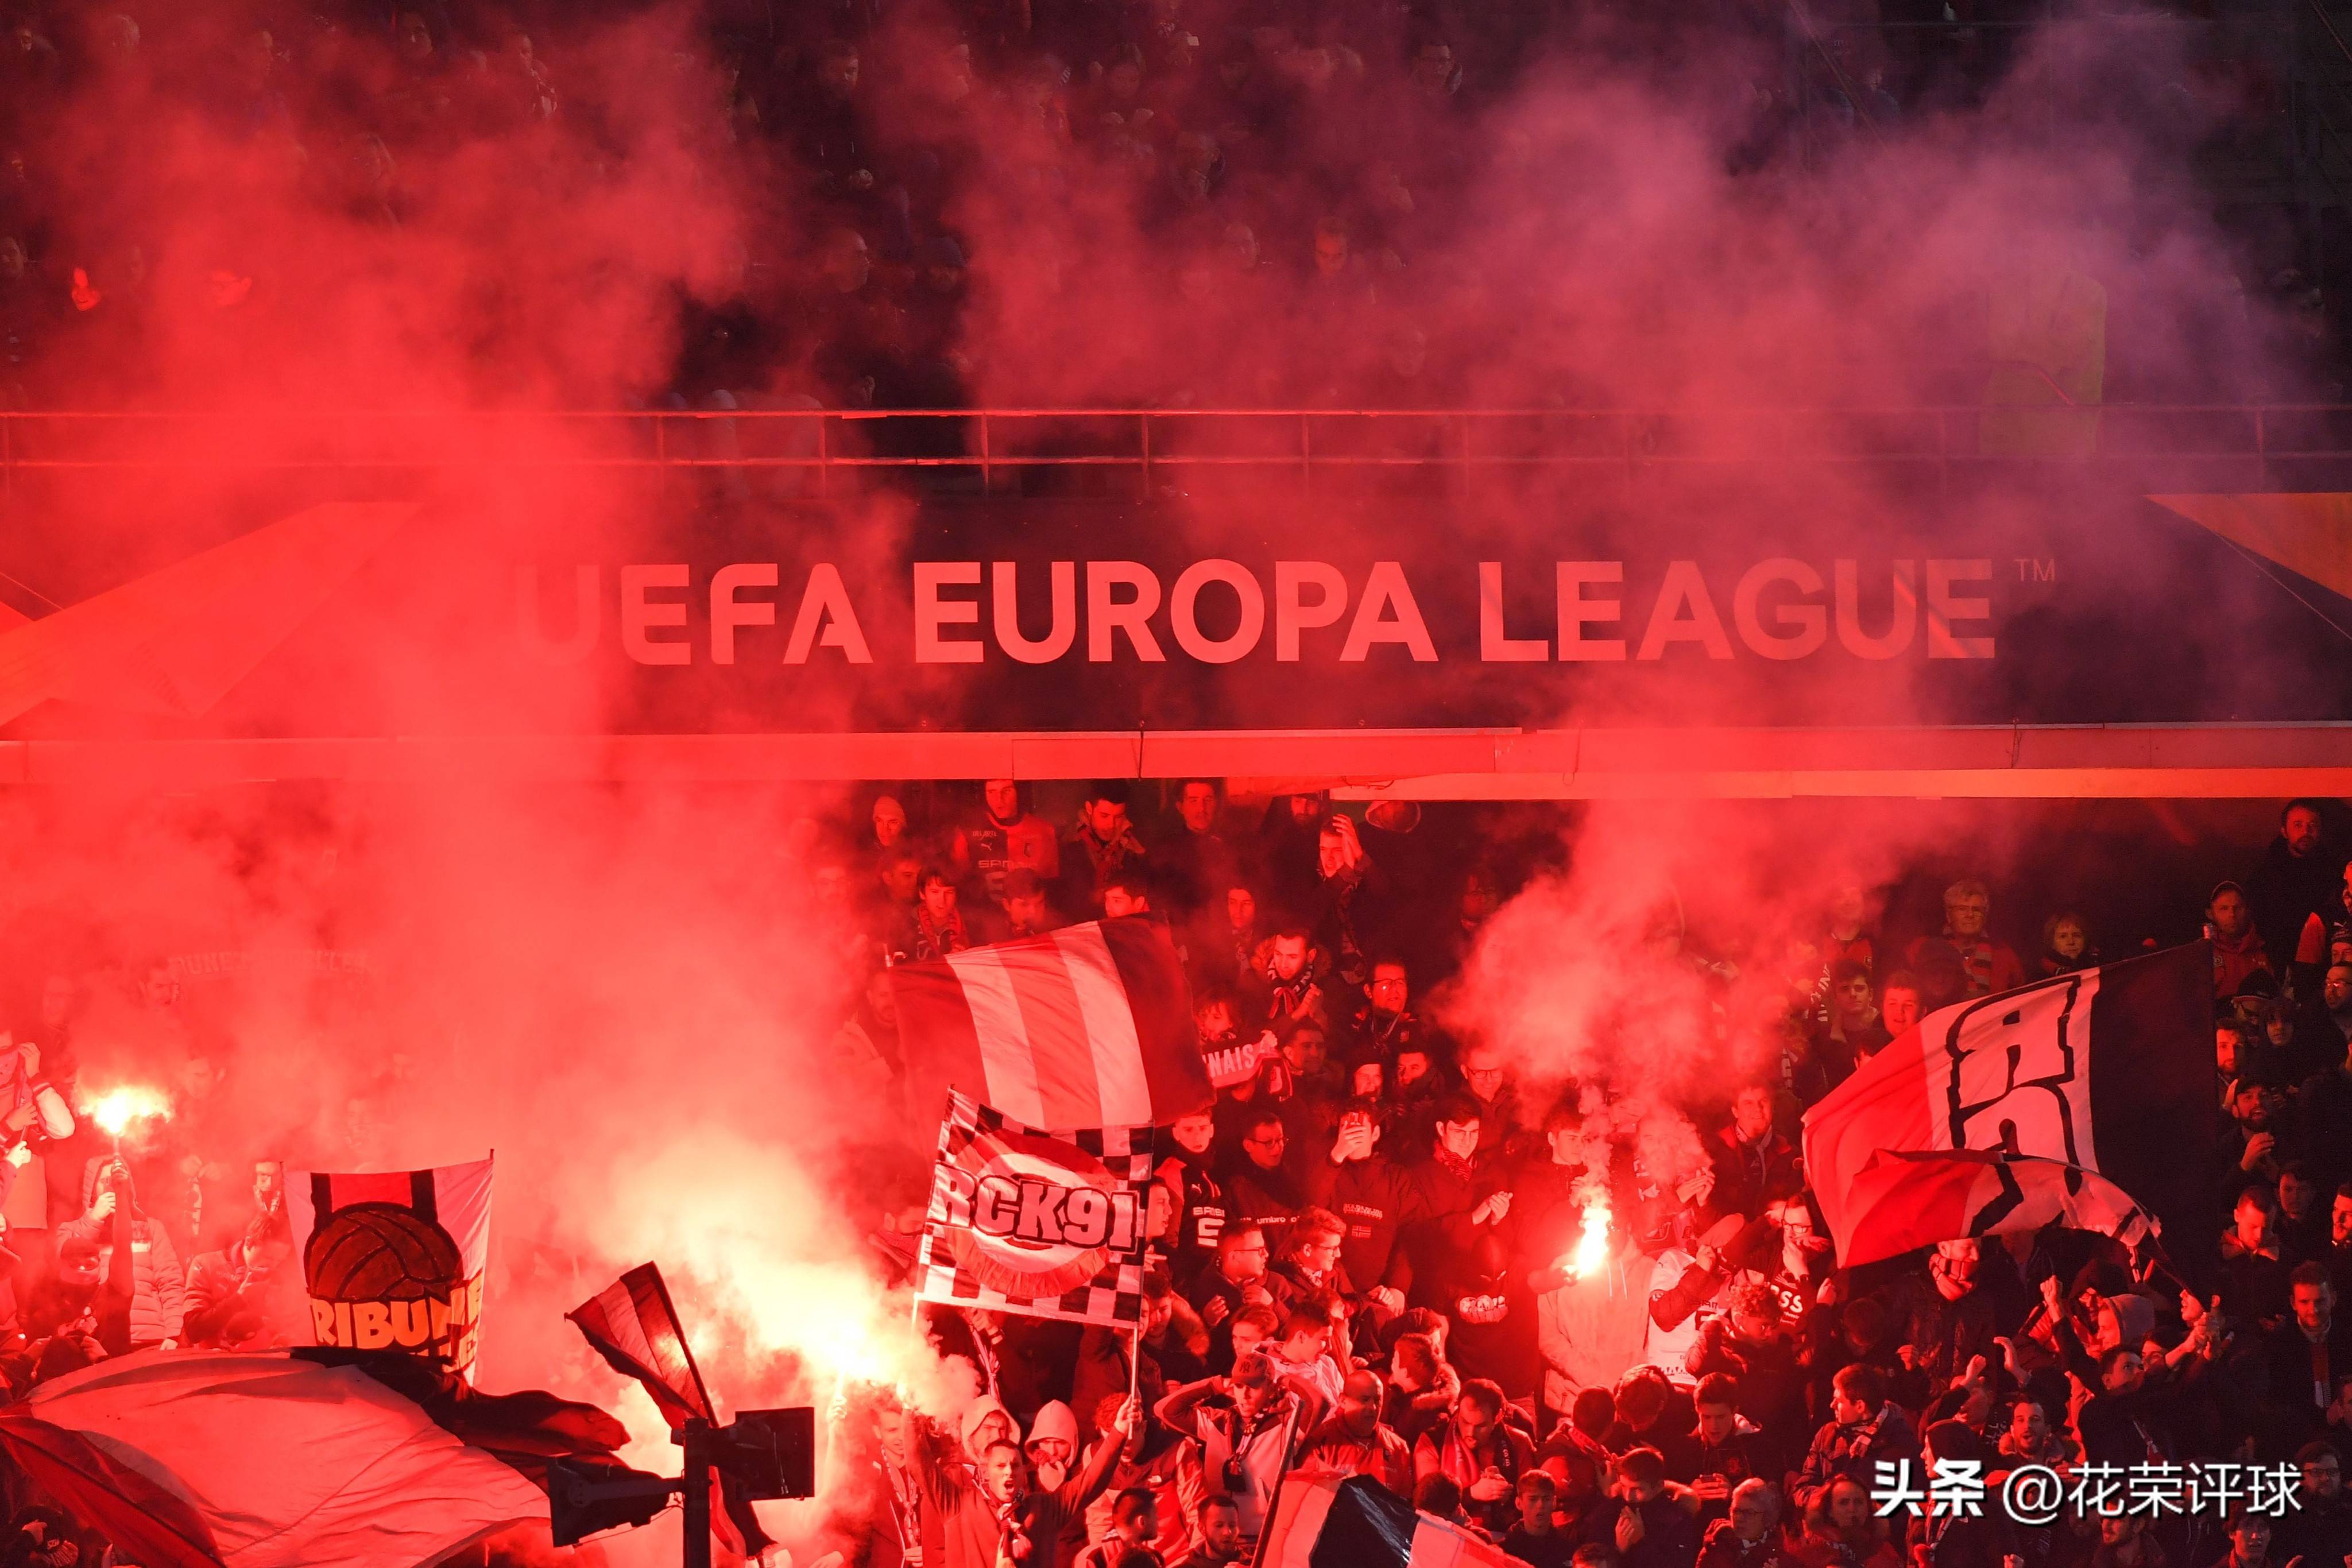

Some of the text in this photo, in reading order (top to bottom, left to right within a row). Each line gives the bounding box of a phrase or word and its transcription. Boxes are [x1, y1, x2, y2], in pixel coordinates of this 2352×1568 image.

[514, 557, 2056, 665] UEFA EUROPA LEAGUE TM
[1202, 1044, 1255, 1078] NAIS
[1257, 1216, 1286, 1224] umbro
[311, 1269, 483, 1349] RIBUNE
